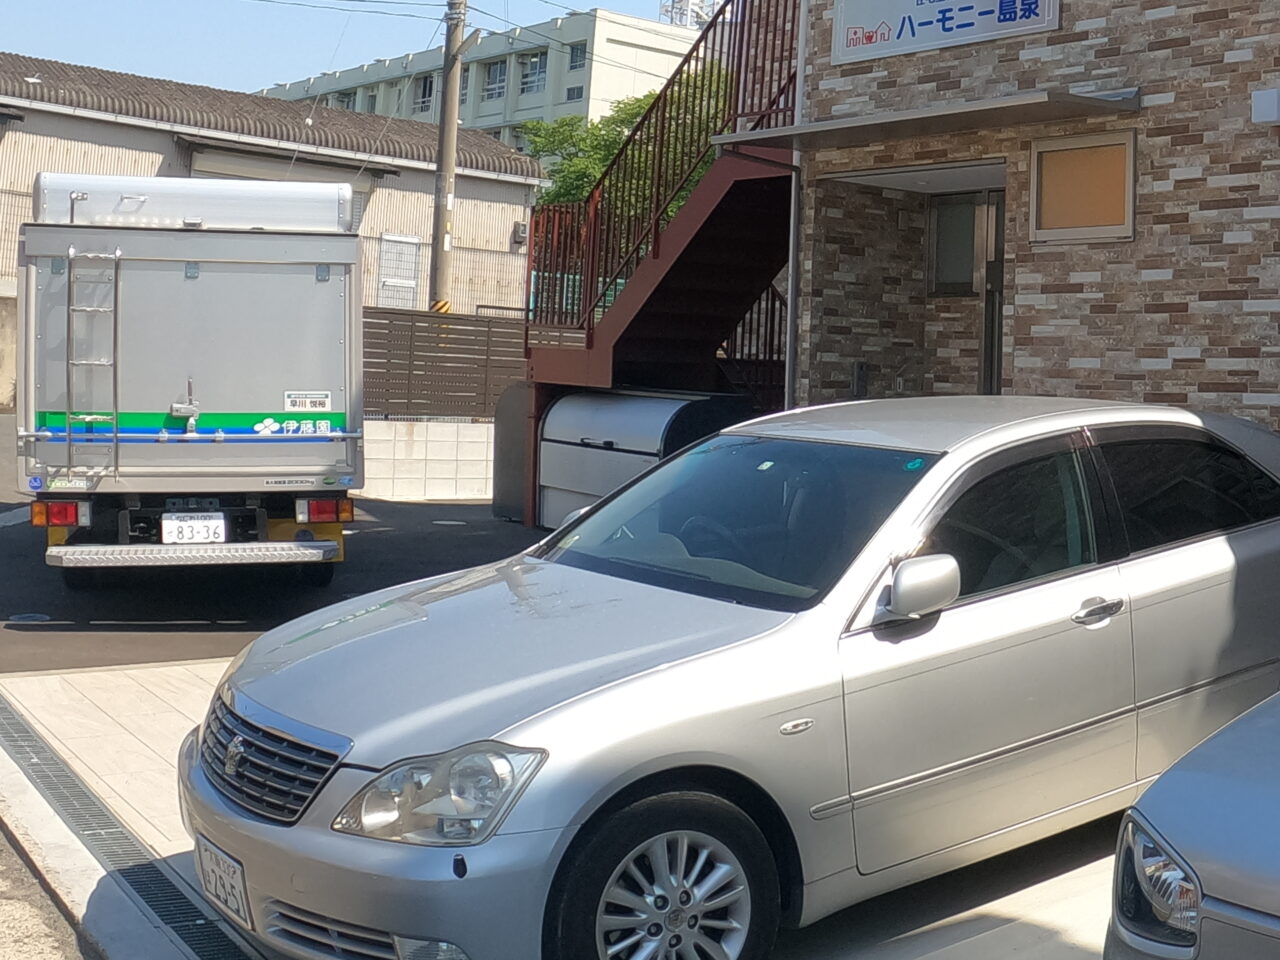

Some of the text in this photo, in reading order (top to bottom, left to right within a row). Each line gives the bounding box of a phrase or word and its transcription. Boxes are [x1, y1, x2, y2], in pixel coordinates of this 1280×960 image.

[281, 420, 331, 435] 伊藤園
[176, 525, 221, 540] 83-36
